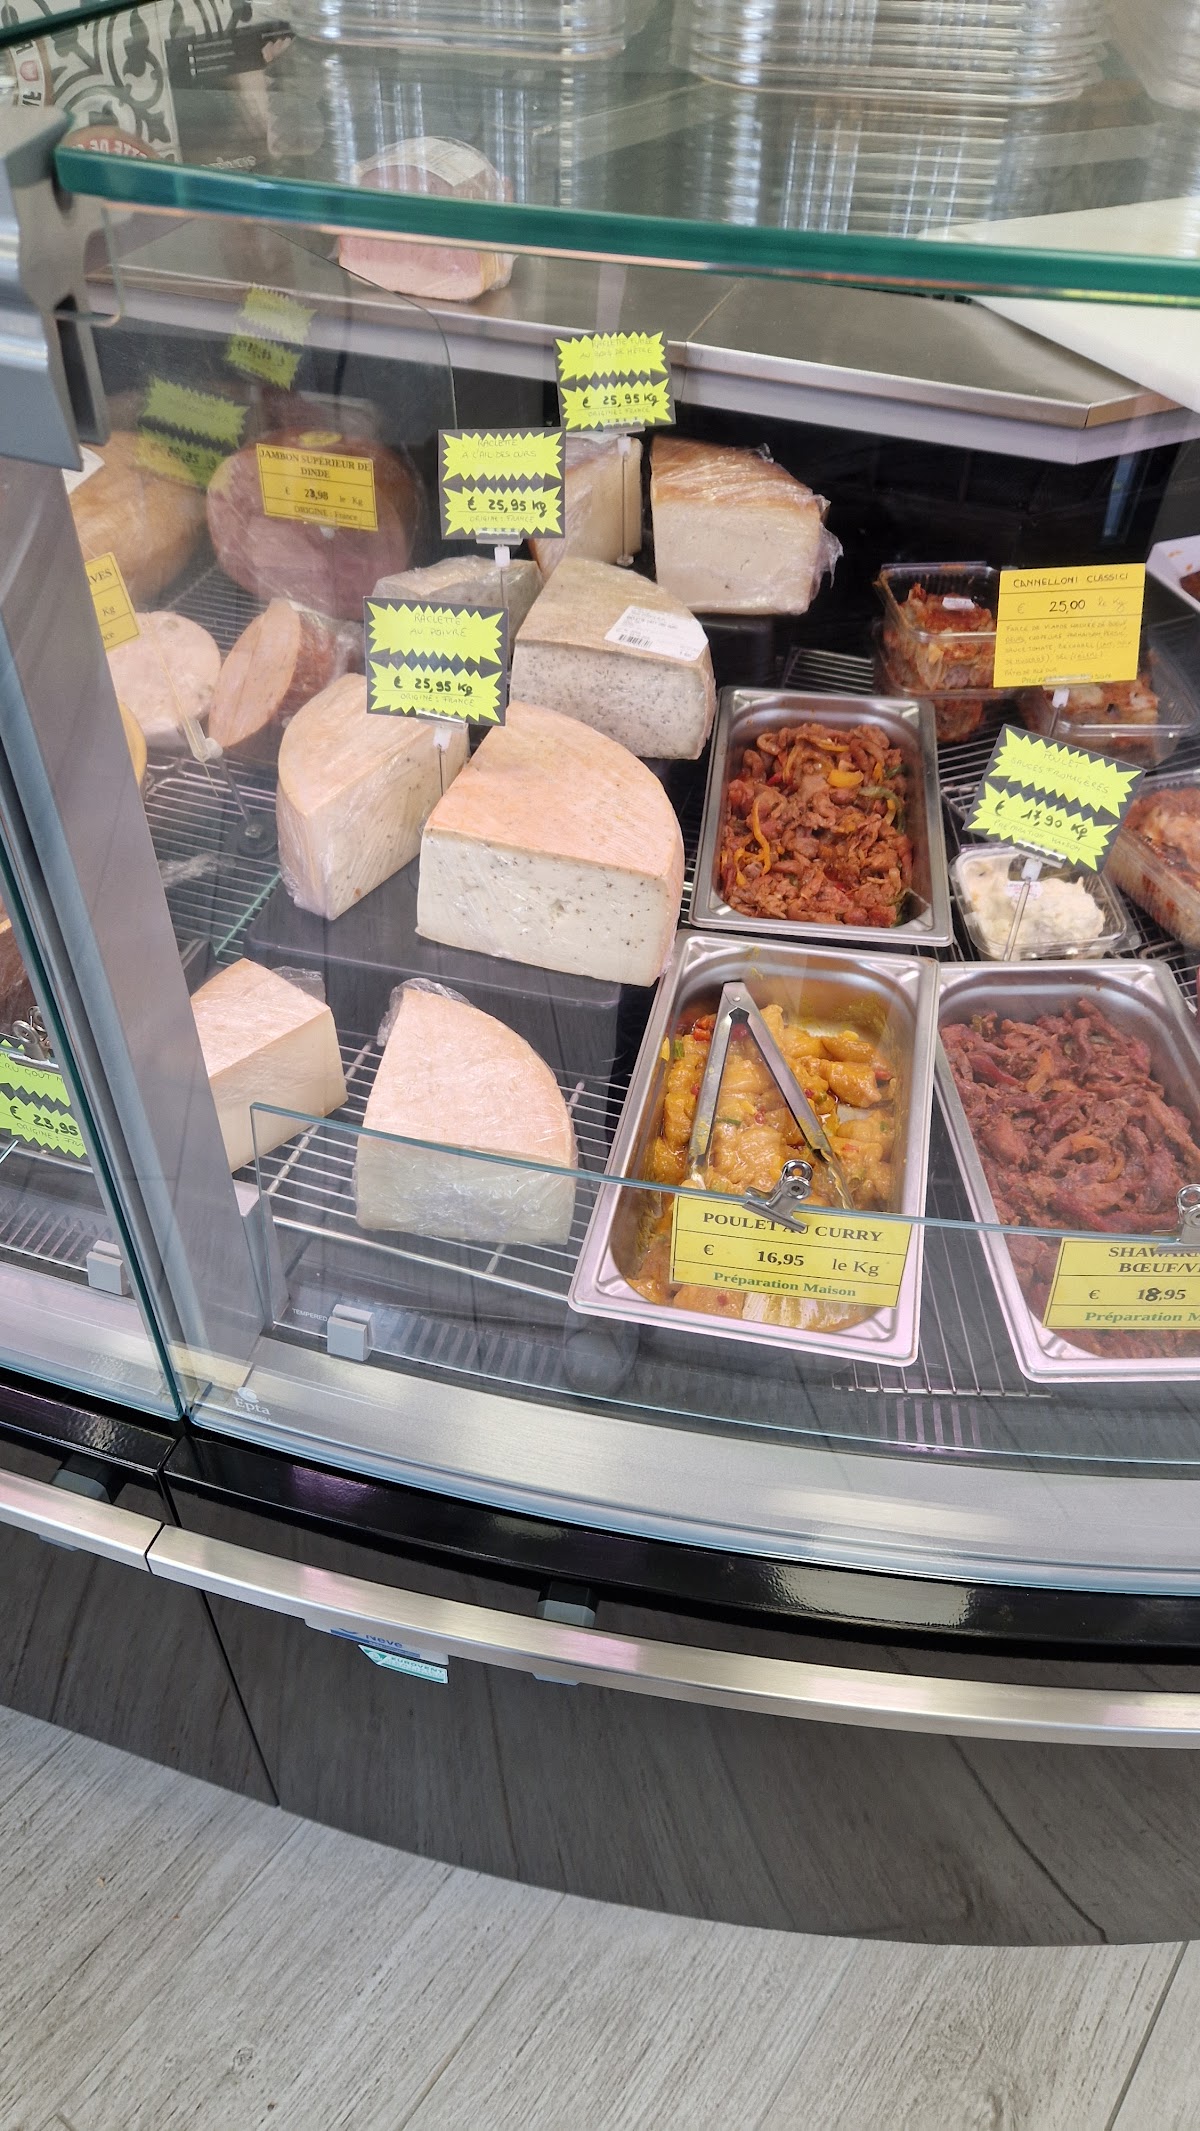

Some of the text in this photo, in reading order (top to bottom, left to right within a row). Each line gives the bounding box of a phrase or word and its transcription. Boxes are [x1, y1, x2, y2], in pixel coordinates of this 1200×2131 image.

[603, 393, 640, 407] 25,95
[260, 449, 299, 462] JAMBON
[357, 462, 372, 472] DE
[300, 466, 330, 479] DINDE
[488, 498, 527, 513] 25,95
[1013, 572, 1129, 588] CANNELLONI CLASSICI
[1049, 599, 1086, 614] 25,00
[414, 613, 461, 625] RACLETTE
[409, 628, 468, 638] AU POIVRE
[414, 677, 452, 693] 25,95
[400, 692, 433, 702] ORIGINE
[443, 696, 475, 707] FRANCE
[1043, 750, 1083, 768] POULET
[1020, 809, 1063, 828] 17,90
[16, 1122, 53, 1140] ORIGINE
[33, 1114, 79, 1136] 23,95
[703, 1212, 782, 1232] POULET
[815, 1225, 883, 1242] CURRY
[703, 1244, 880, 1277] € 16,95 le Kg
[713, 1271, 856, 1297] Préparation Maison
[1089, 1287, 1187, 1302] € 18,95
[291, 1308, 328, 1321] TEMPERED
[1084, 1312, 1182, 1324] Préparation
[233, 1396, 271, 1415] Epta
[391, 1656, 443, 1674] EUROVENT
